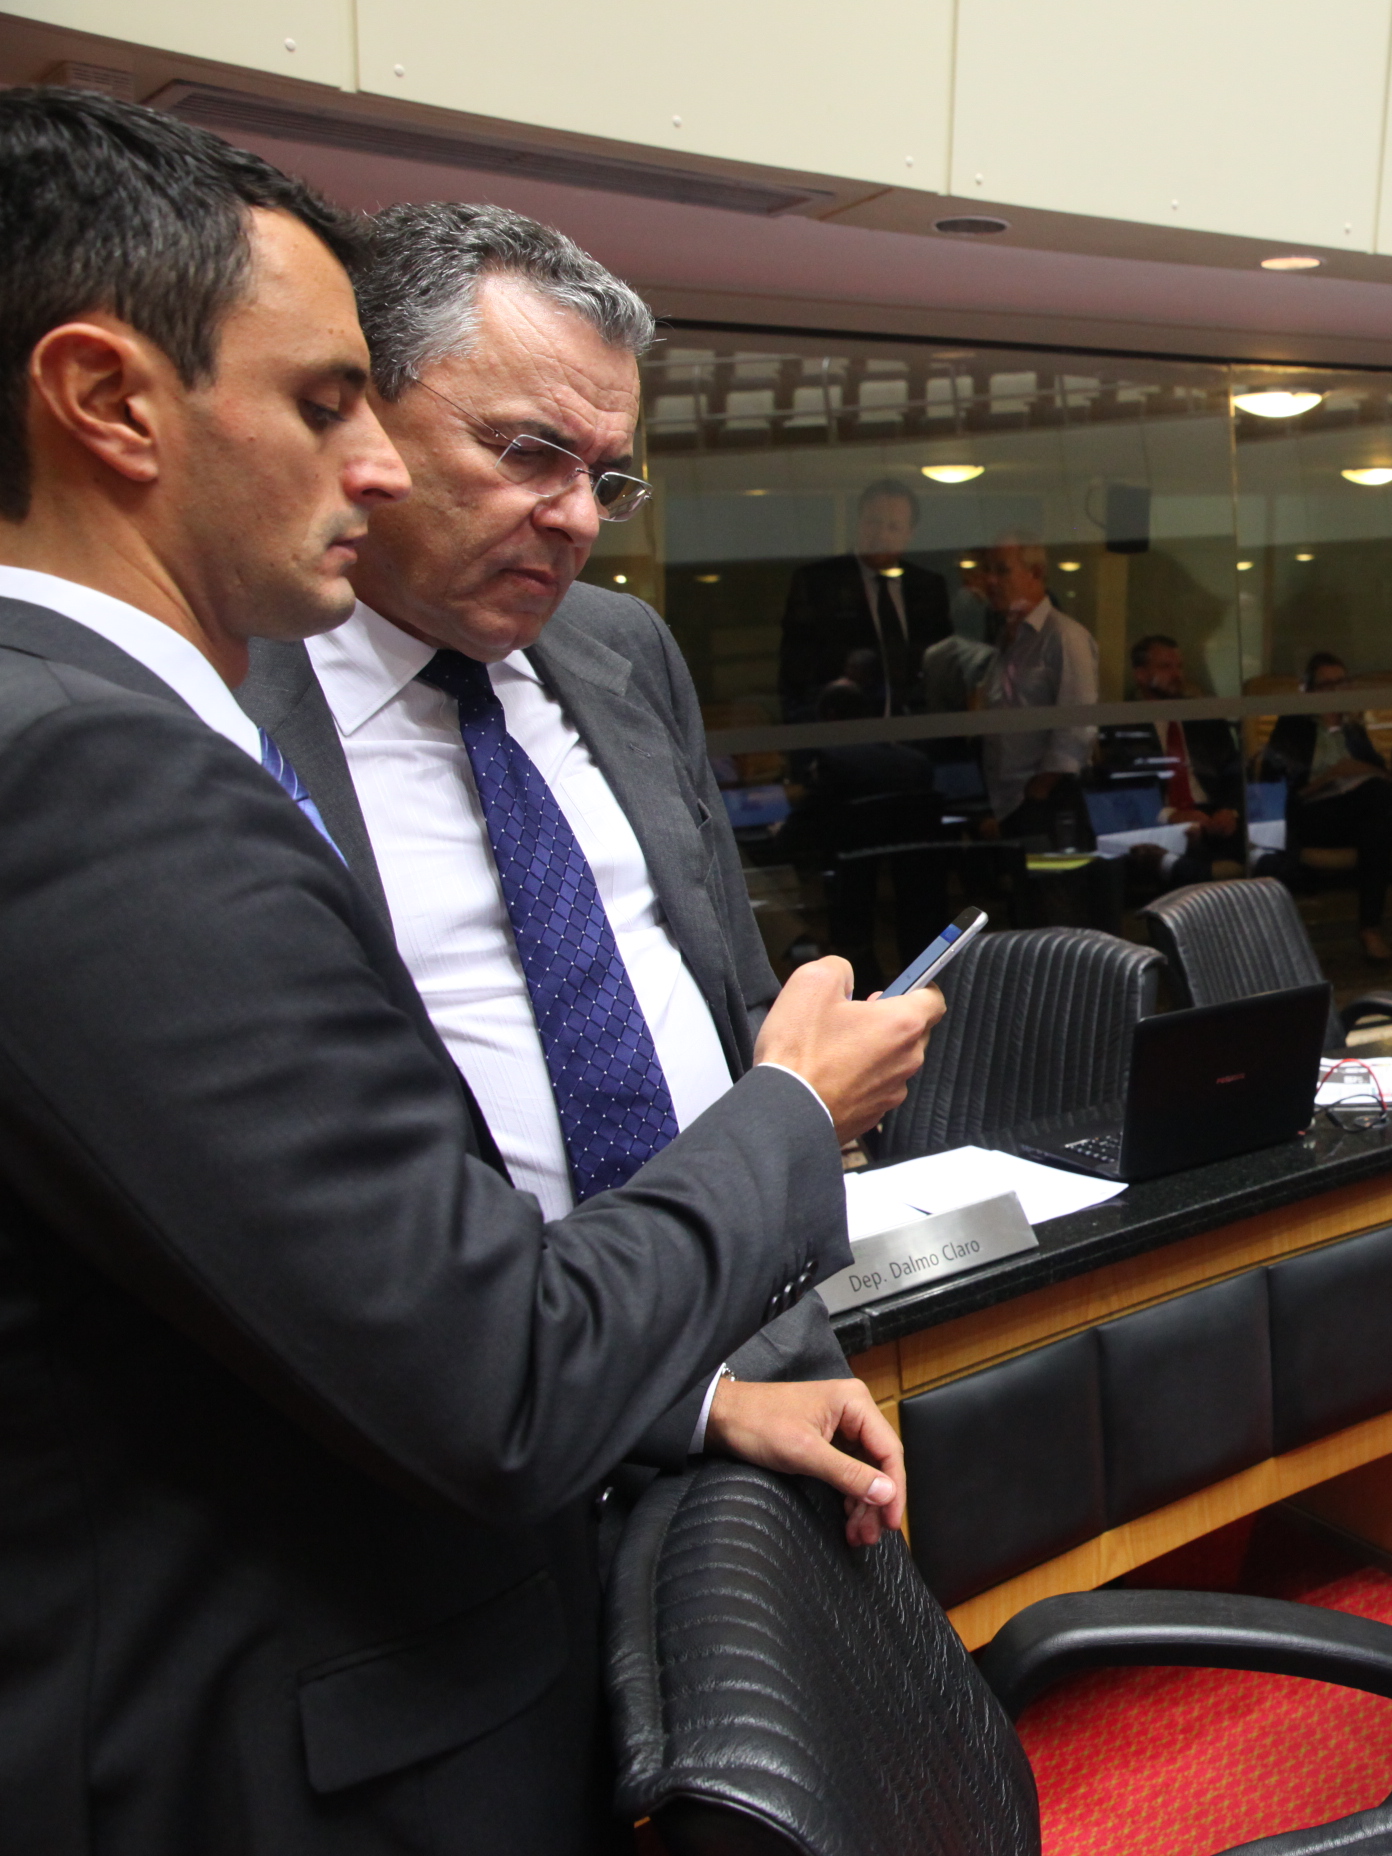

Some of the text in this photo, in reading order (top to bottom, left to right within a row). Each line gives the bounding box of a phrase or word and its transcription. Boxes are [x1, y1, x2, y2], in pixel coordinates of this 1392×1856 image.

[849, 1240, 980, 1293] Dep. Dalmo Claro
